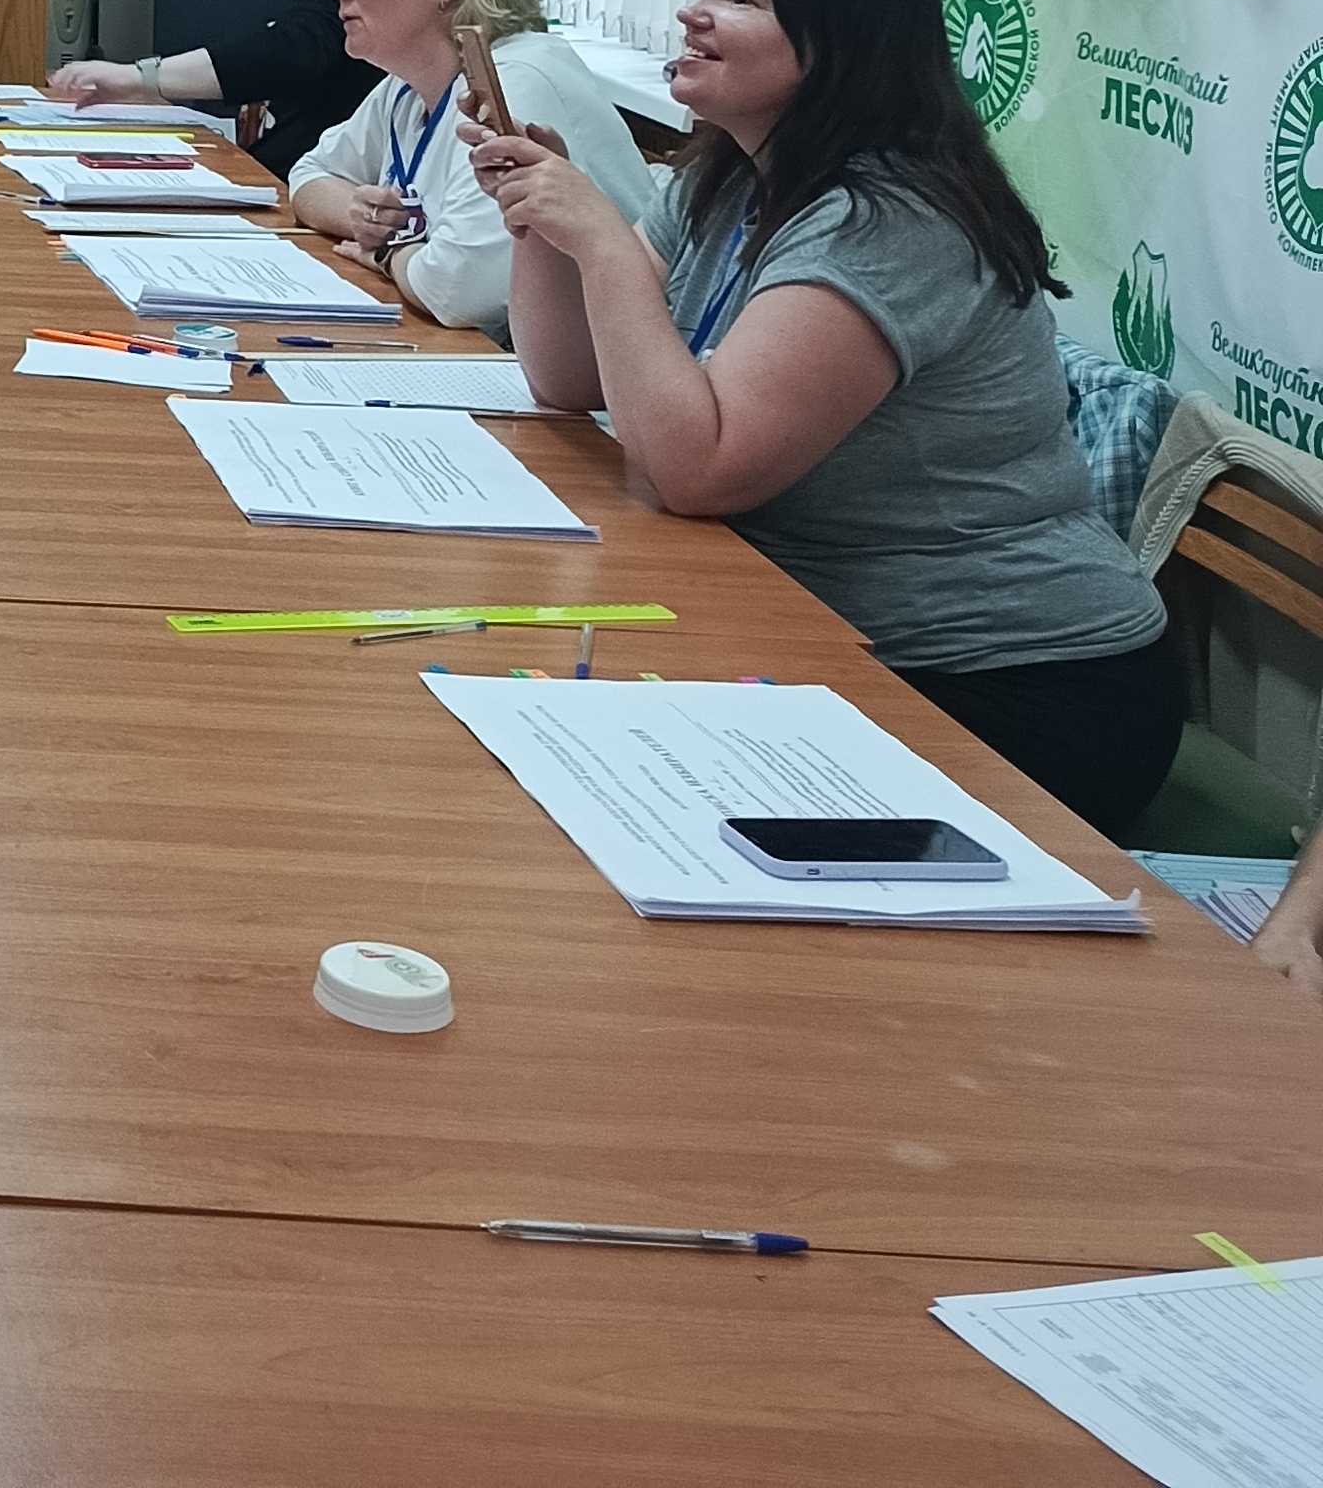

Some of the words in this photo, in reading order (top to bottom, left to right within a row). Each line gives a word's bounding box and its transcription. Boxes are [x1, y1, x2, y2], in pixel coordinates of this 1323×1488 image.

[994, 29, 1040, 133] ВОЛОГОДСКОЙ
[1101, 77, 1194, 155] ЛЕСХОЗ
[1264, 141, 1278, 225] ЛЕСНОГО
[626, 728, 707, 786] ИЗБИРАТЕЛЕЙ
[693, 788, 739, 816] ПИСКА
